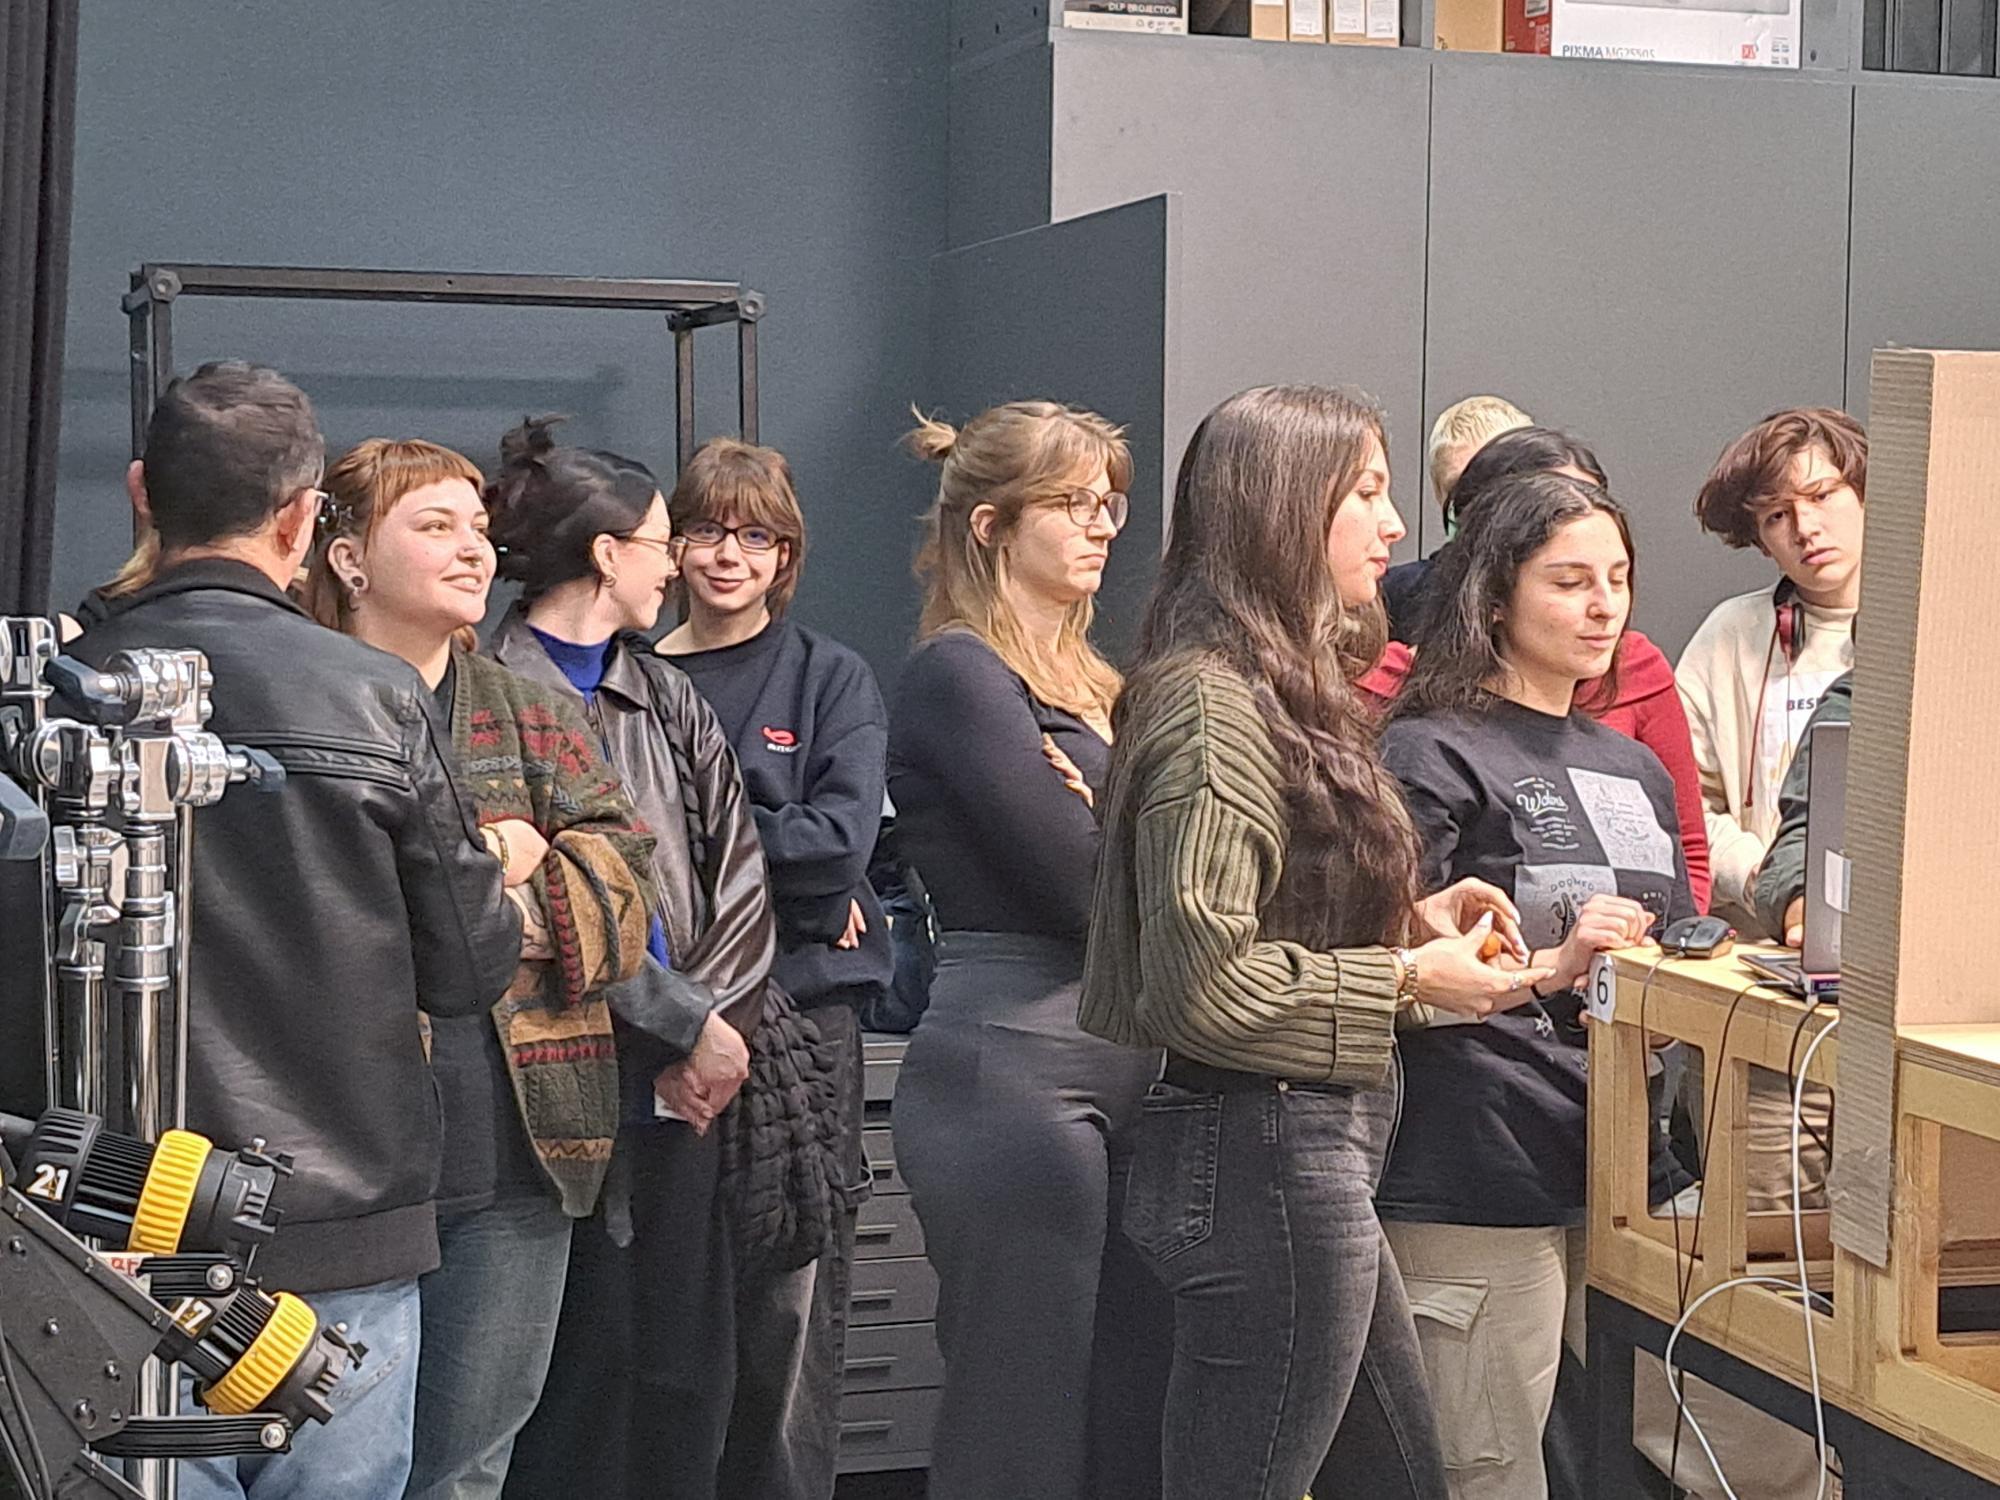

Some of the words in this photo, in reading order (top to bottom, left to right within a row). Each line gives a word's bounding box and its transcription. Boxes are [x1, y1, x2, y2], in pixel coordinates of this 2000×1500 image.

[1108, 2, 1126, 12] DLP
[1127, 3, 1177, 15] PROJECTOR
[1562, 44, 1604, 58] PIXMA
[1597, 966, 1609, 1006] 6
[26, 1163, 70, 1201] 21
